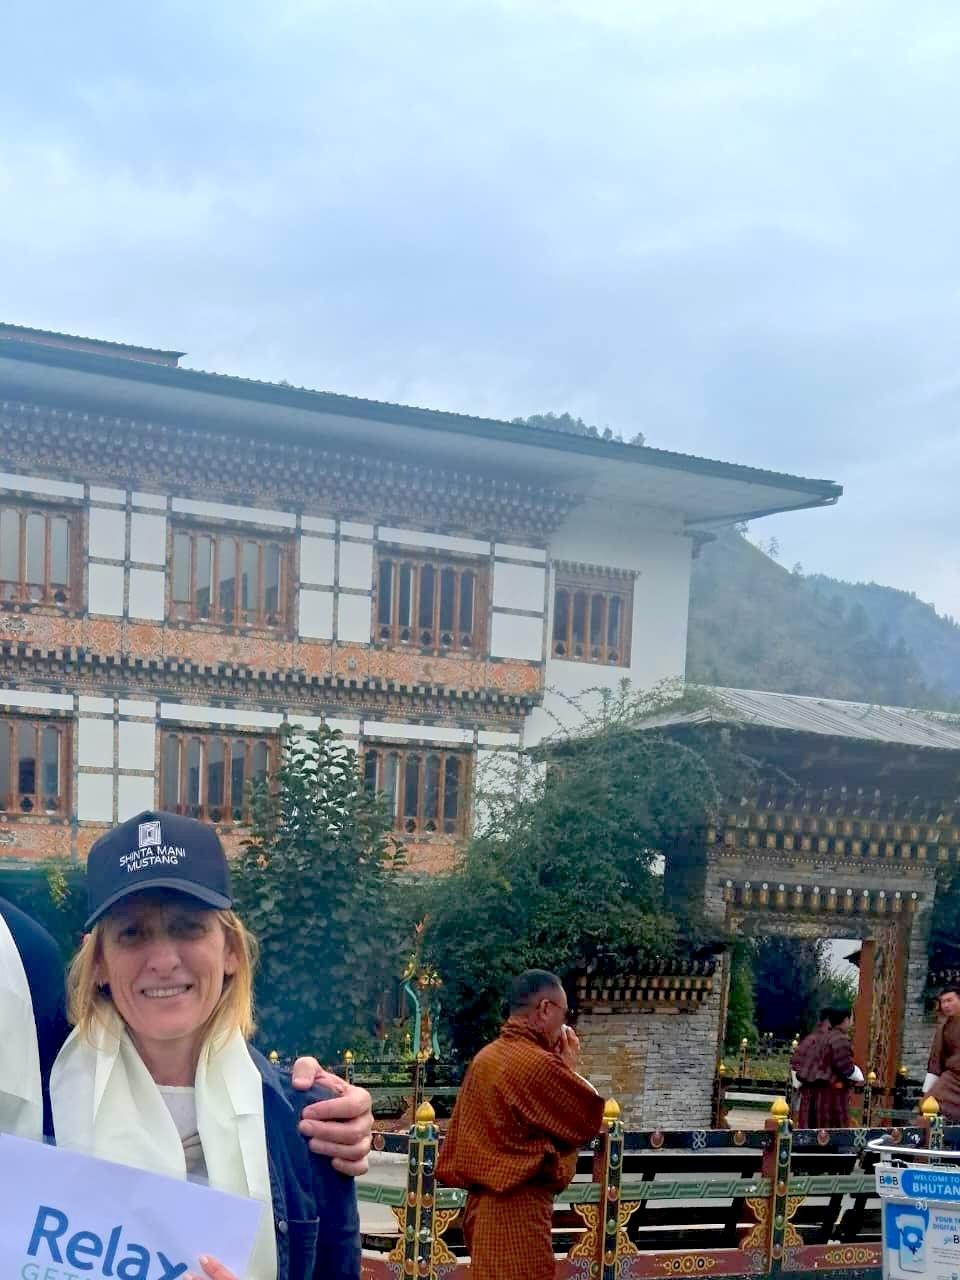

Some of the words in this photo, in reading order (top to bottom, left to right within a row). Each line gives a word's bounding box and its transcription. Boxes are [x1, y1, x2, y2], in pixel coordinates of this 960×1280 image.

[119, 847, 153, 867] SHINTA
[157, 845, 186, 857] MANI
[127, 855, 178, 872] MUSTANG
[913, 1174, 948, 1183] WELCOME
[912, 1182, 960, 1196] BHUTAN
